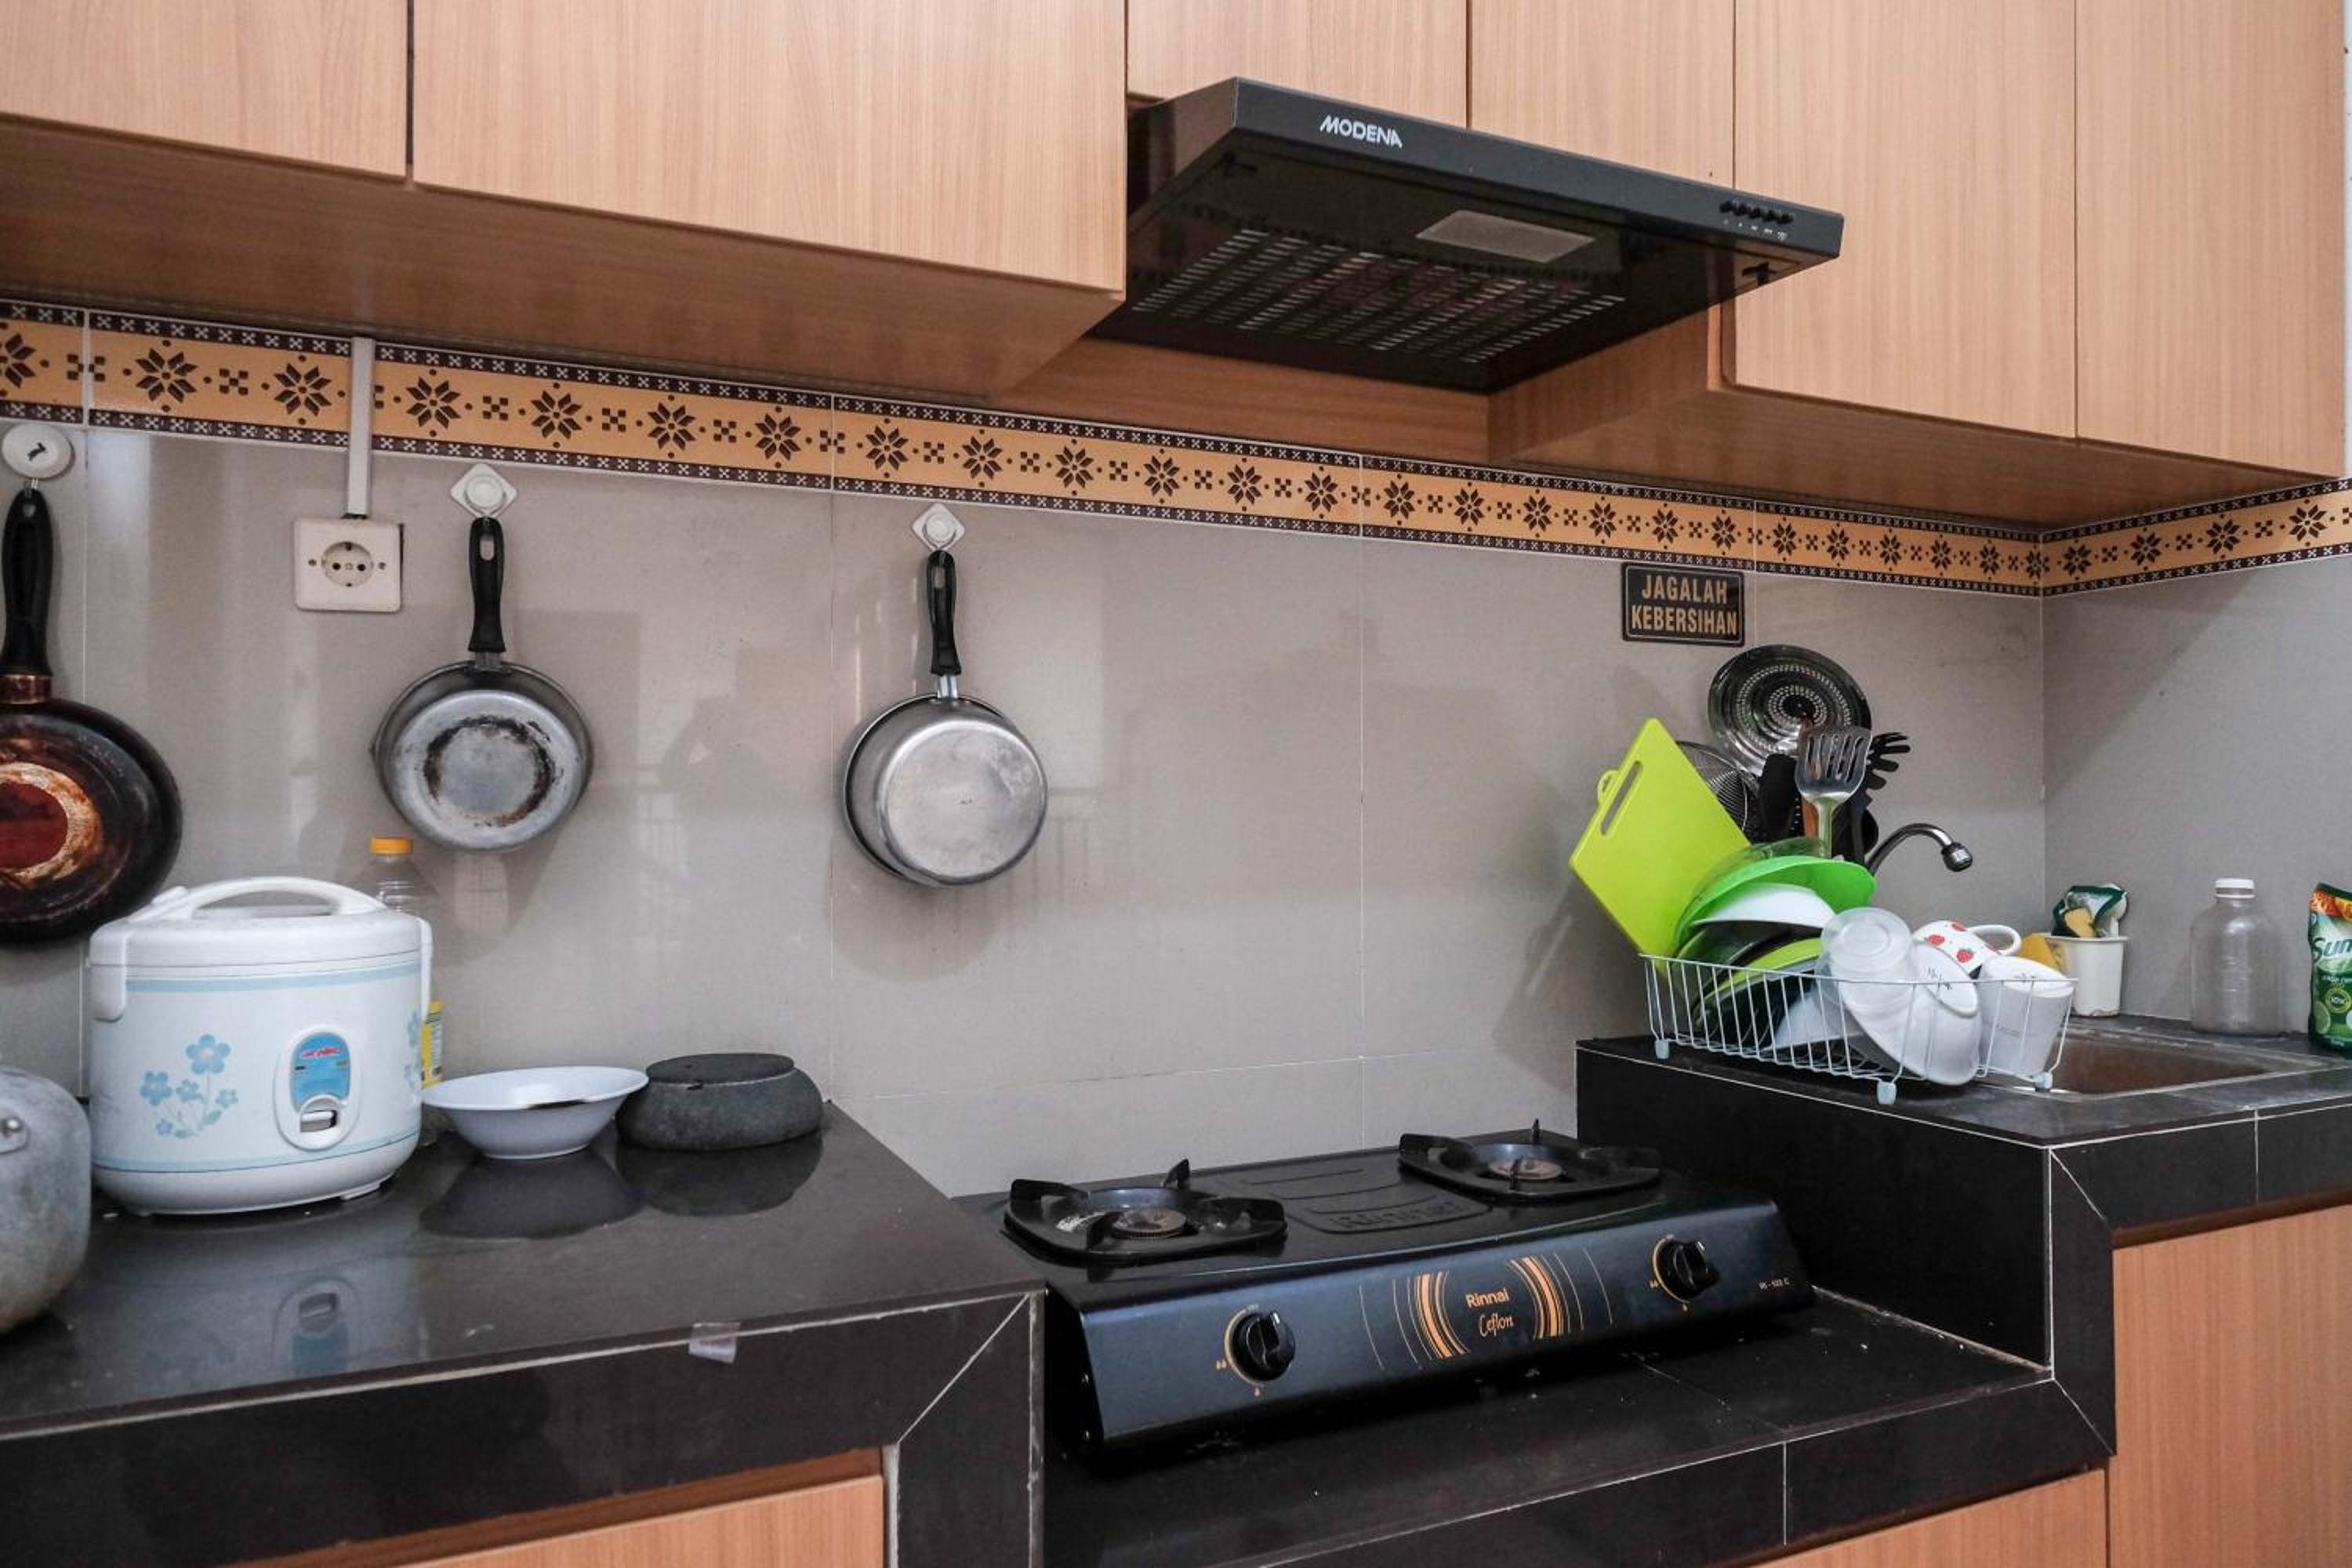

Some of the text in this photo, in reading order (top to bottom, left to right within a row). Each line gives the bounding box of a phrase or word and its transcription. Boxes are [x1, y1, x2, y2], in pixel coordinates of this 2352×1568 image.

[1319, 115, 1403, 148] MODENA
[1642, 574, 1728, 604] JAGALAH
[1631, 604, 1737, 636] KEBERSIHAN
[1465, 1287, 1510, 1308] Rinnai
